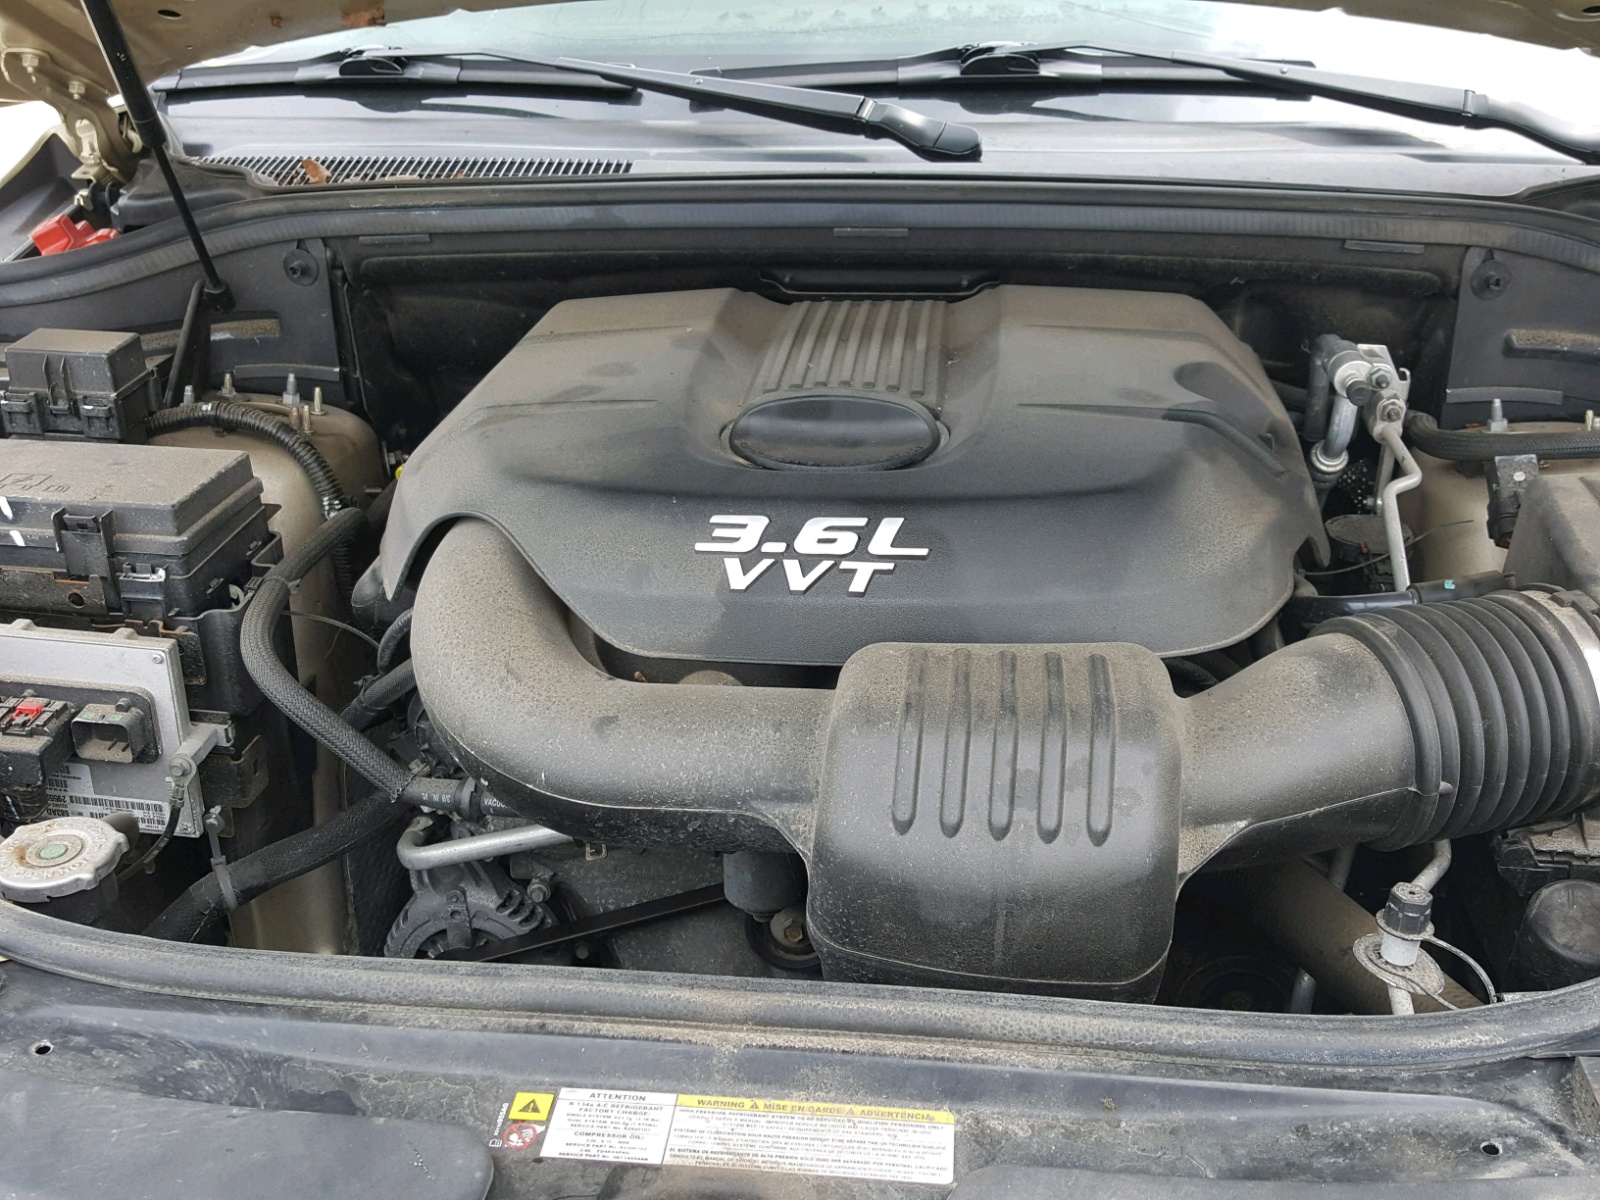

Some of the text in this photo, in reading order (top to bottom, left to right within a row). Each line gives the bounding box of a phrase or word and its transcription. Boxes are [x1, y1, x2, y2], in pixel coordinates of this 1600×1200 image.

[695, 515, 930, 556] 3.6L
[723, 557, 896, 594] VVT
[484, 797, 511, 808] VACUU
[589, 1092, 646, 1101] ATTENTION
[610, 1104, 664, 1112] REFRIGERANT
[697, 1099, 745, 1109] WARNING
[763, 1103, 788, 1112] MISE
[790, 1104, 805, 1112] EN
[808, 1105, 844, 1114] GARDE
[728, 1110, 770, 1118] REFRIGERANT
